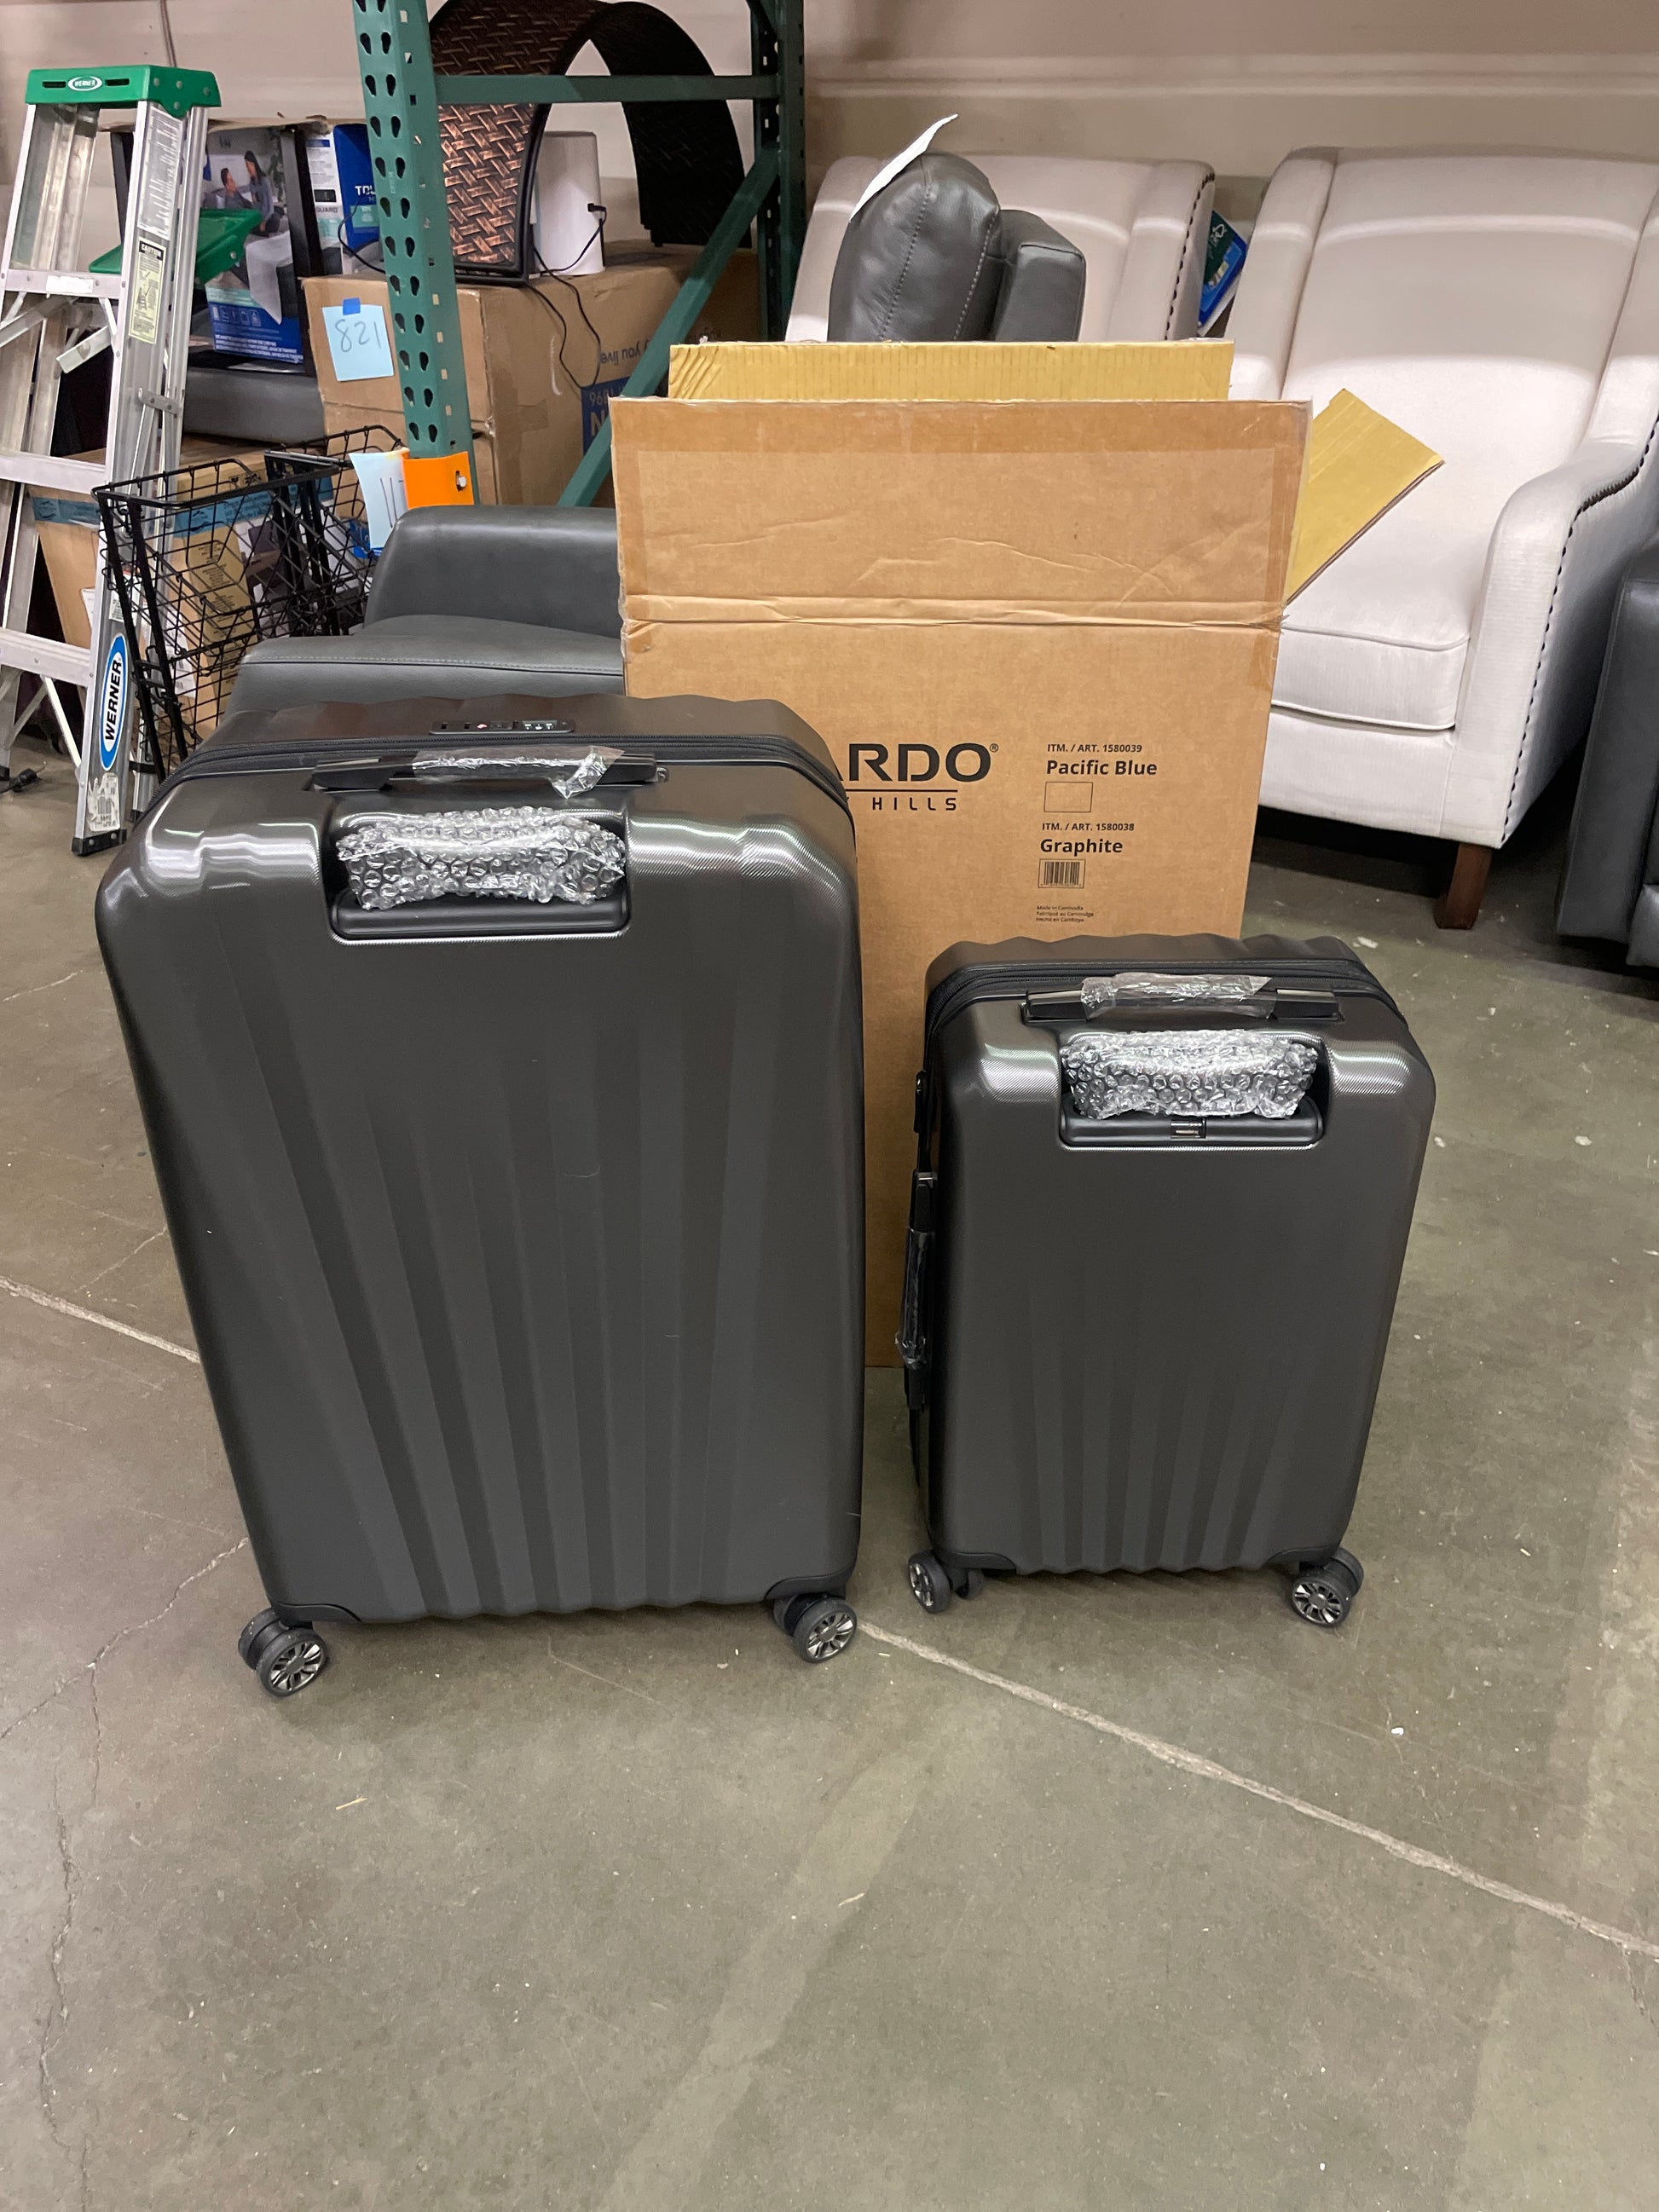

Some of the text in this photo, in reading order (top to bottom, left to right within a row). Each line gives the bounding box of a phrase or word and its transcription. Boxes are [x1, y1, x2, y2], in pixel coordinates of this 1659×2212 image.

[335, 319, 381, 353] 821
[622, 341, 641, 357] you
[600, 351, 620, 366] live
[105, 659, 122, 741] WERNER
[1047, 743, 1068, 753] ITM.
[1077, 744, 1100, 753] ART.
[1102, 744, 1142, 753] 1580039
[1046, 759, 1158, 775] Pacific Blue
[872, 797, 957, 811] HILLS
[1042, 823, 1062, 831] ITM.
[1072, 823, 1093, 831] ART.
[1095, 823, 1135, 831] 1580038
[1040, 838, 1123, 857] Graphite
